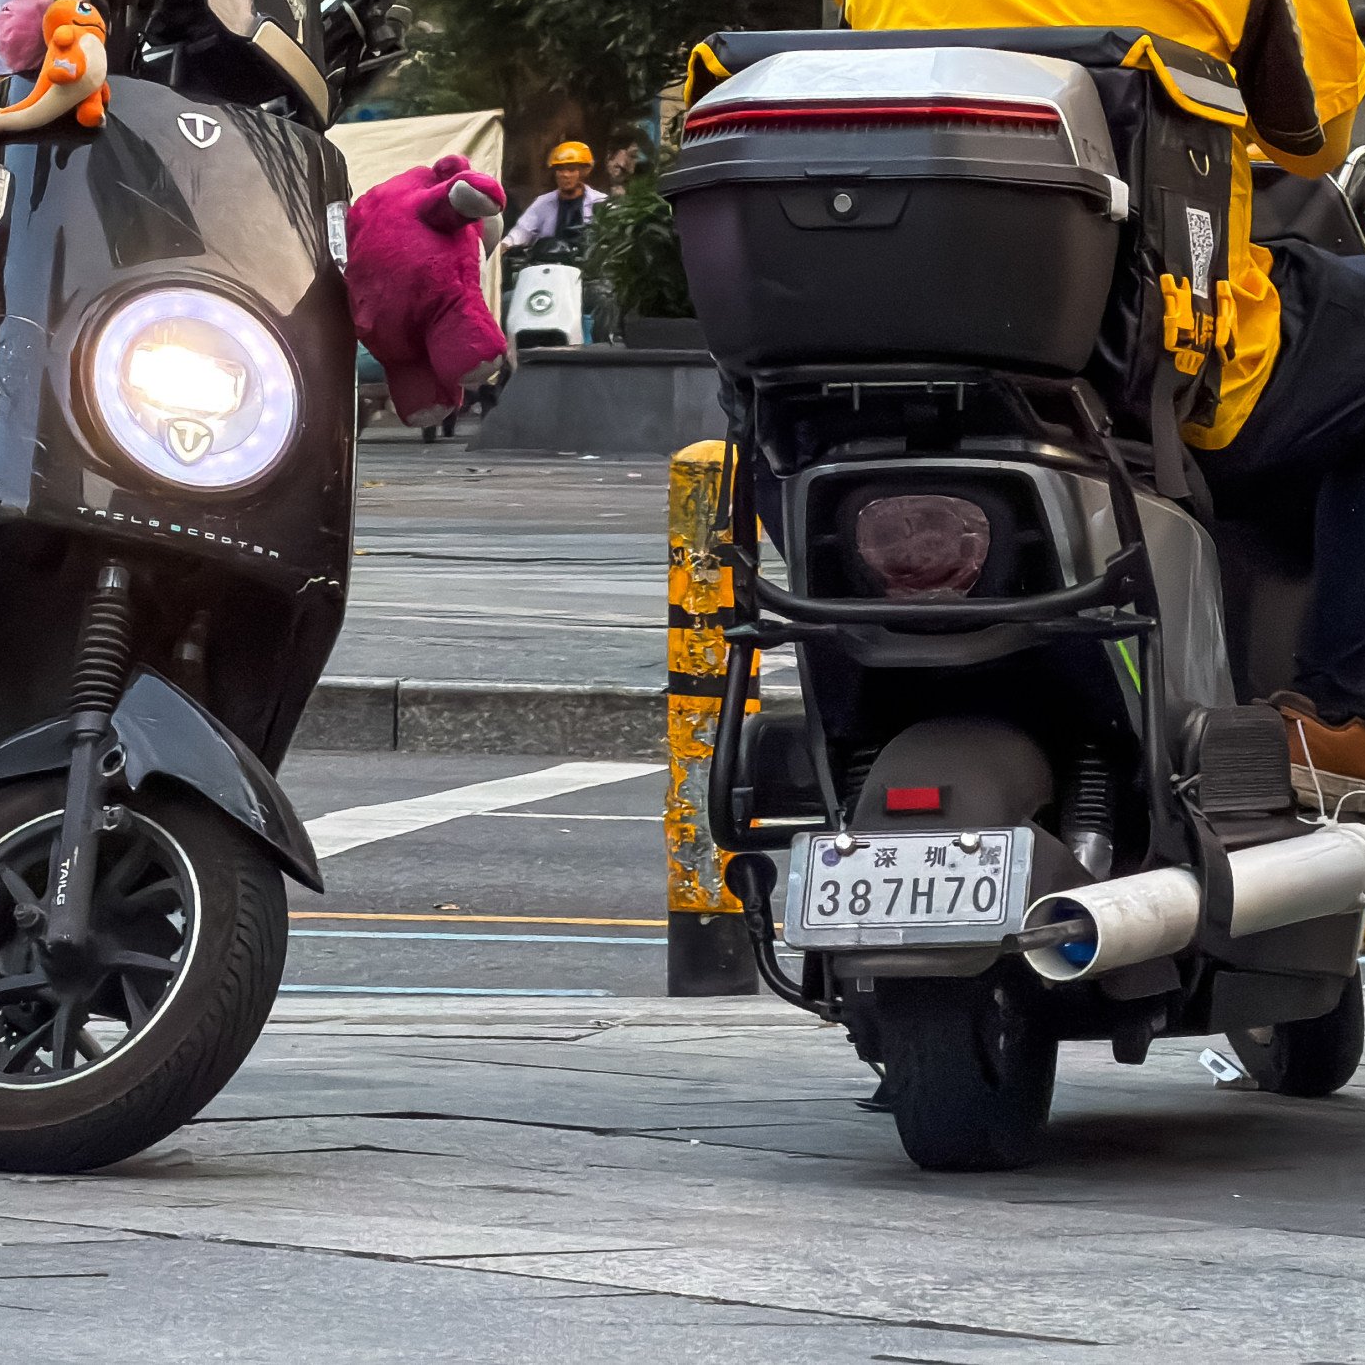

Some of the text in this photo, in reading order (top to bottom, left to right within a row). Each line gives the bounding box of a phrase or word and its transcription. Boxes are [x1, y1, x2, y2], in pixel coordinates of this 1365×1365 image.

[874, 846, 947, 868] 深圳
[56, 858, 70, 906] TAILG
[817, 875, 997, 917] 387H70
